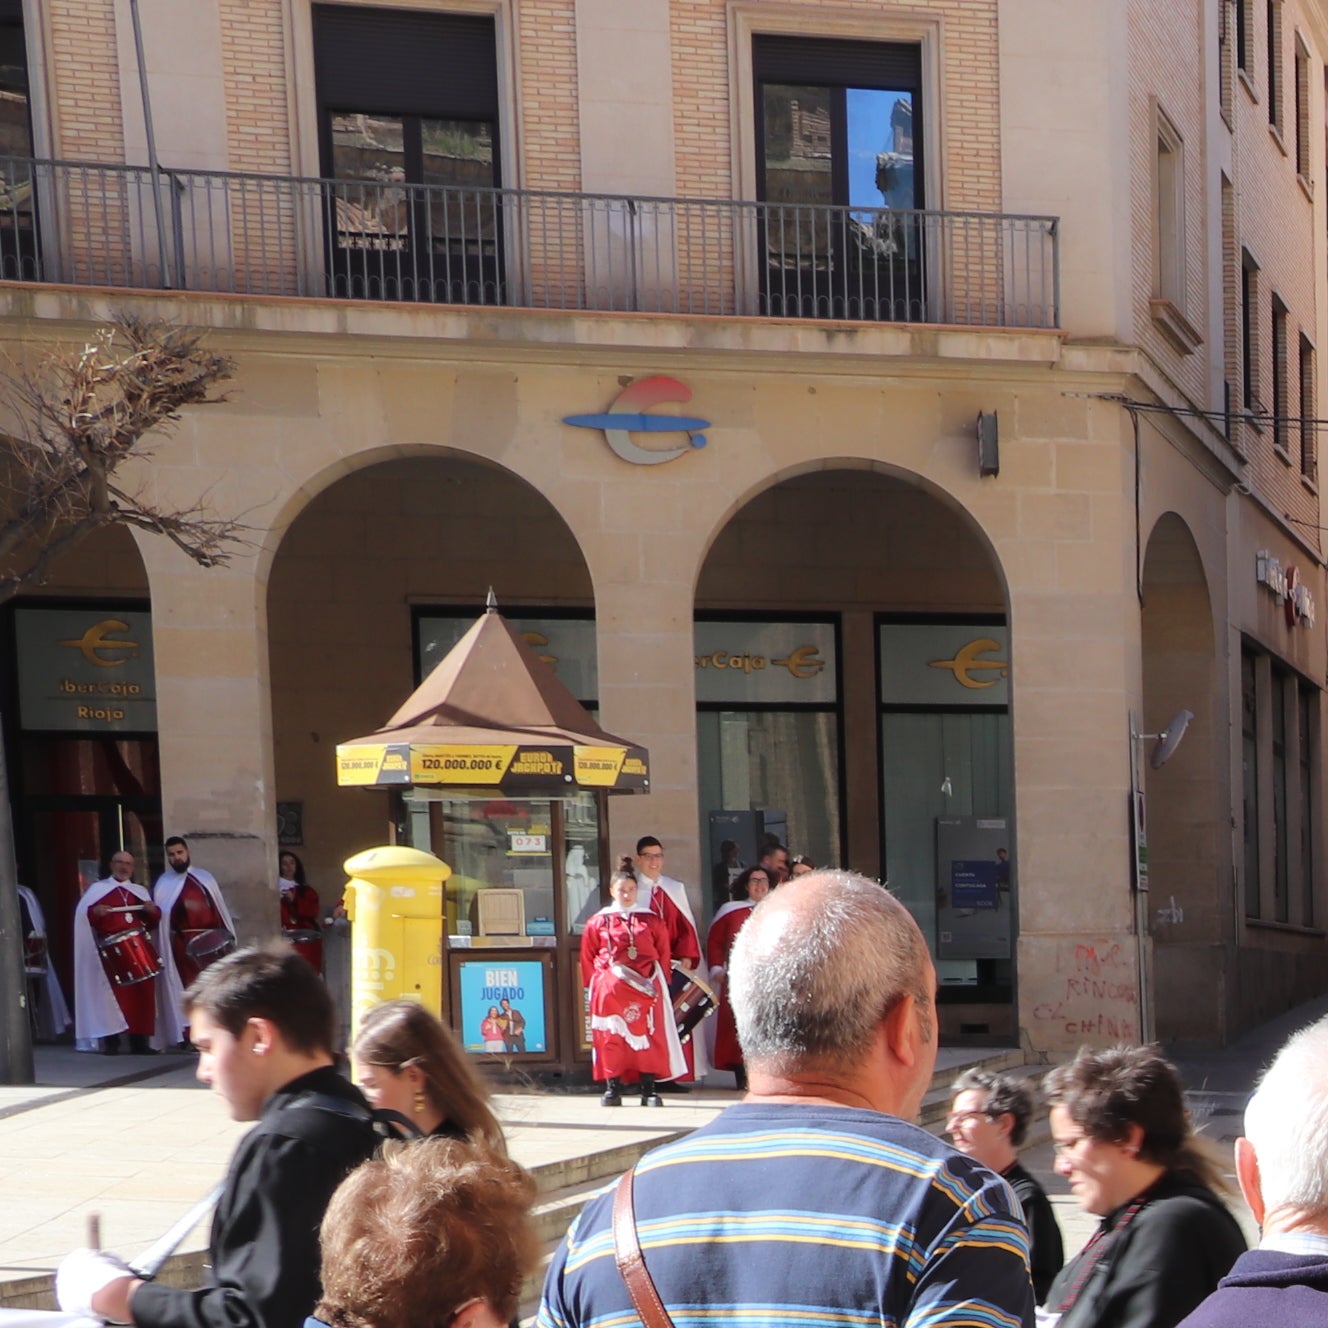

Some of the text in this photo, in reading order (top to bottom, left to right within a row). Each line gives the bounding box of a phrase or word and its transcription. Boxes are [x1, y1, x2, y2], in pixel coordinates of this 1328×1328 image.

[77, 706, 124, 721] Rioja
[422, 759, 492, 769] 120.000.000
[485, 969, 518, 987] BIEN
[481, 987, 525, 1000] JUGADO
